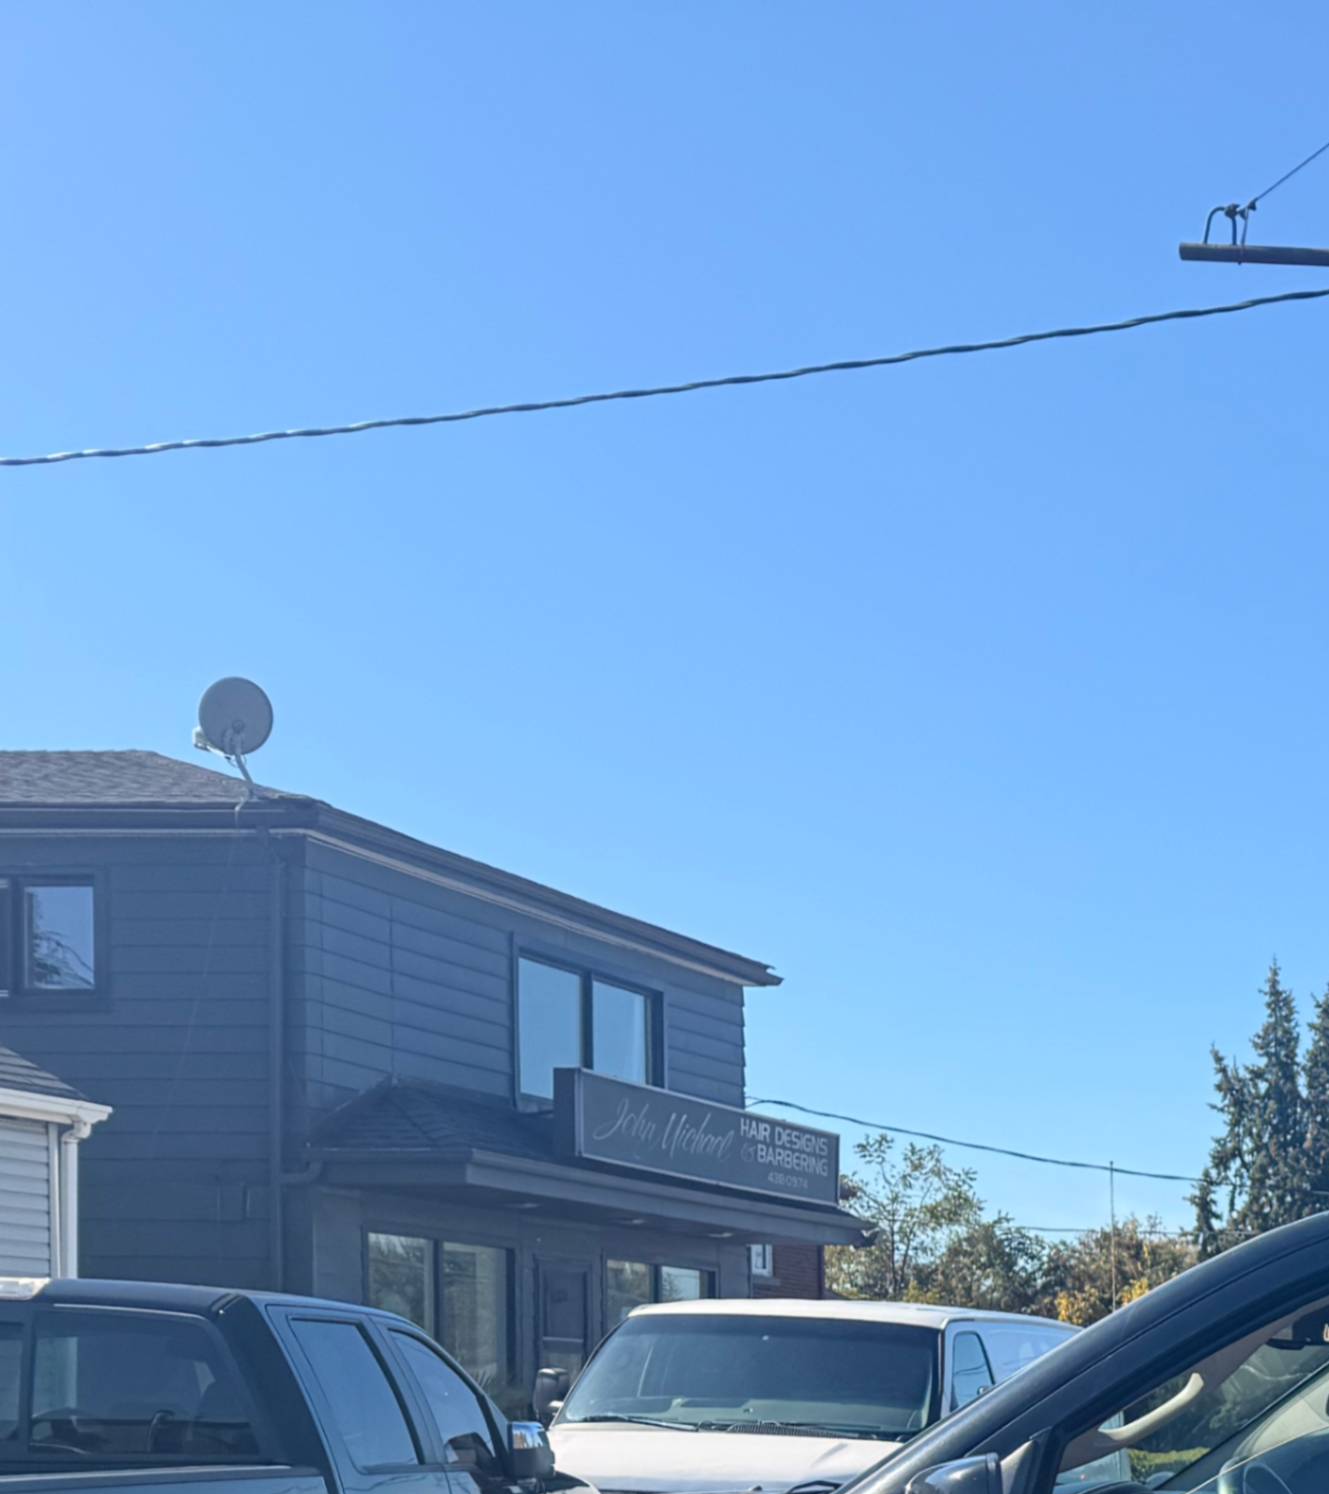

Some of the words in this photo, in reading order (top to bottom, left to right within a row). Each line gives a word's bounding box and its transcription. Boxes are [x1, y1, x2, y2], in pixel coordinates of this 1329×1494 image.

[592, 1097, 657, 1142] John
[661, 1111, 736, 1162] Michael
[740, 1117, 771, 1143] HAIR
[774, 1125, 828, 1156] DESIGNS
[757, 1143, 828, 1176] BARBERING
